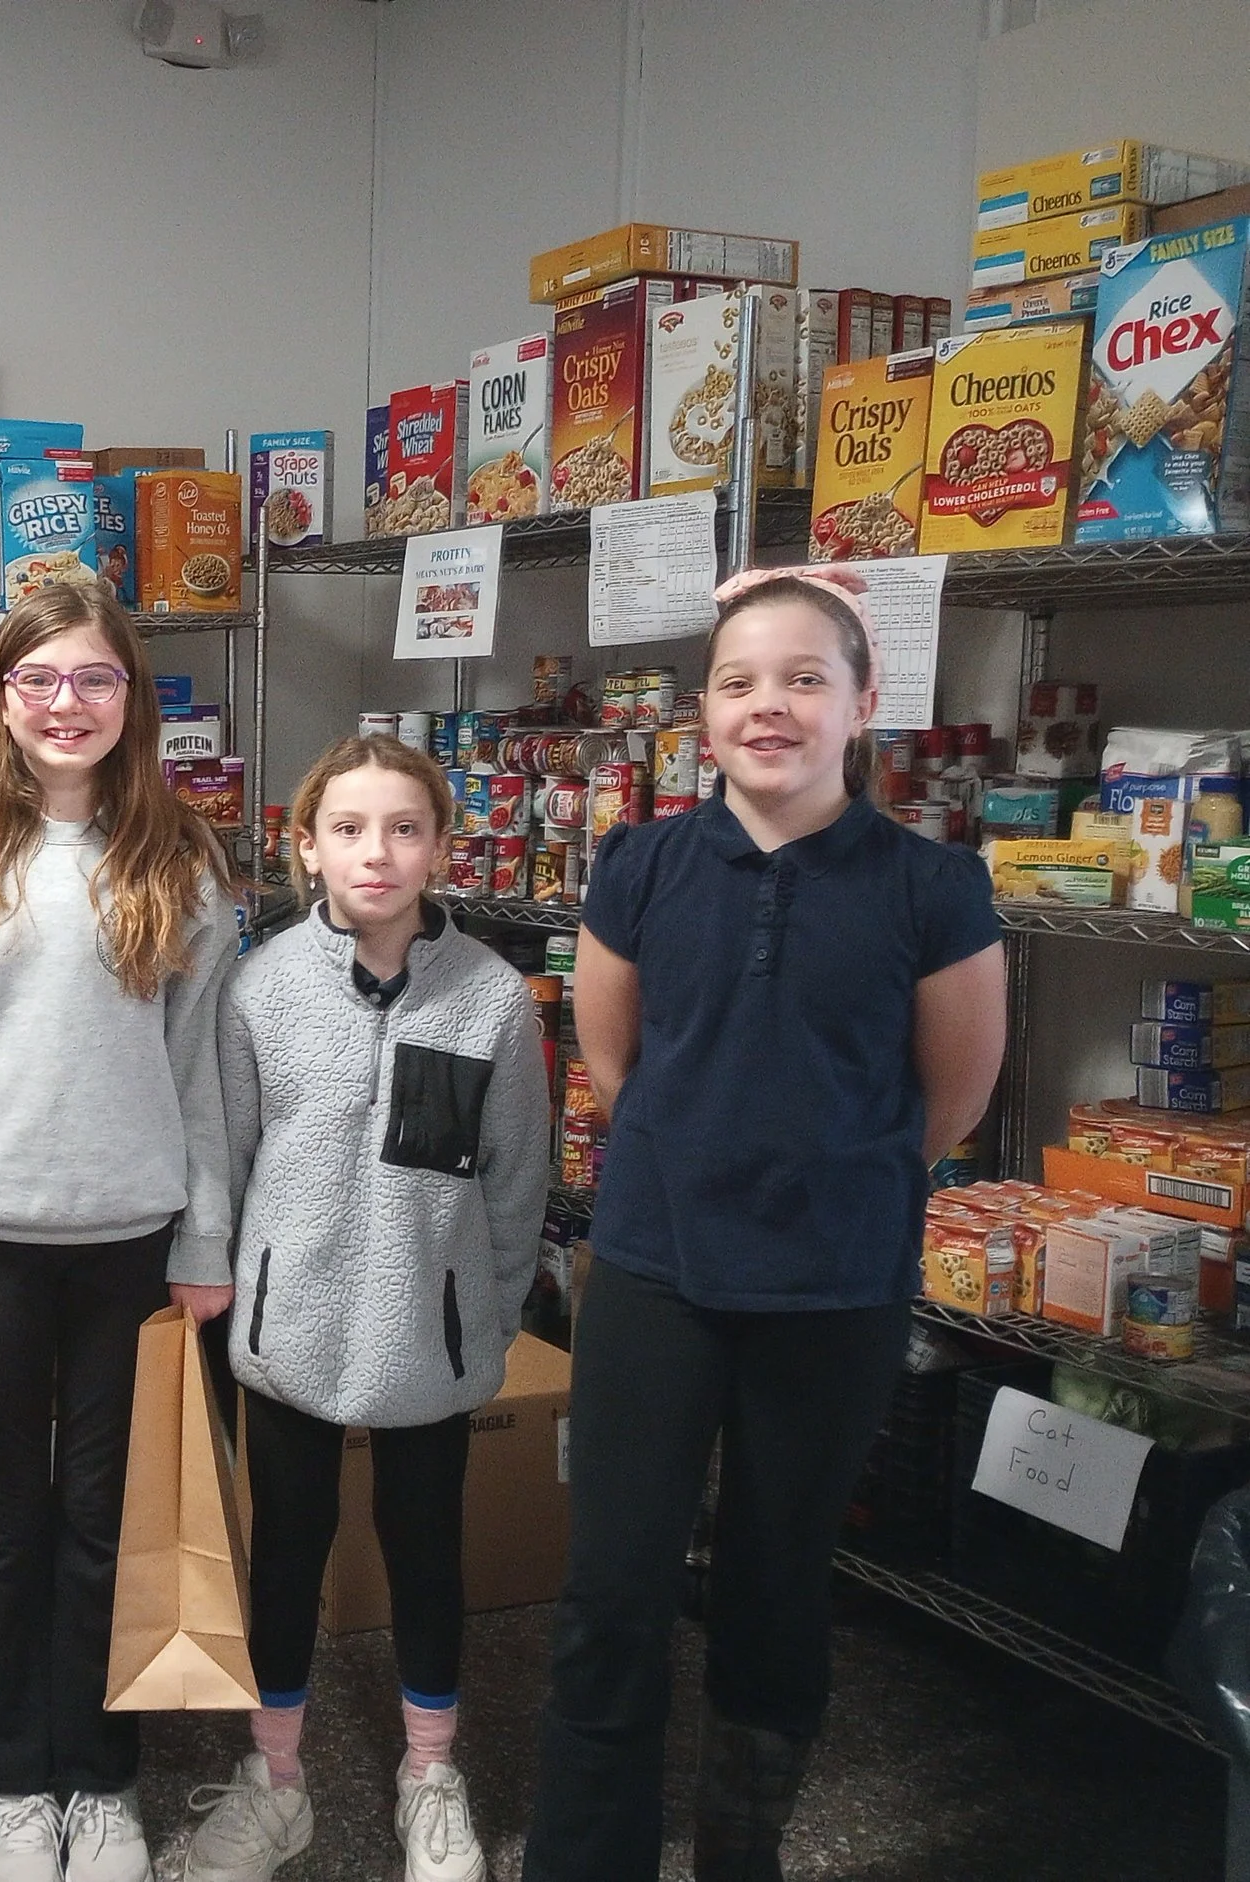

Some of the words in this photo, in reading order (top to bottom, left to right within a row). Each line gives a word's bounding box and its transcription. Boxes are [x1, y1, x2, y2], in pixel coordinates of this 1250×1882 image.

[1032, 190, 1083, 214] Cheerios
[1150, 233, 1199, 264] FAMILY
[1202, 223, 1236, 249] SIZE
[1029, 251, 1081, 273] Cheerios
[1149, 294, 1193, 321] Rice
[1107, 306, 1224, 373] Chex
[563, 350, 622, 383] Crispy
[481, 370, 527, 412] CORN
[568, 382, 609, 411] Oats
[950, 365, 1056, 408] Cheerios
[830, 396, 914, 435] Crispy
[967, 408, 994, 419] 100%
[1014, 401, 1042, 414] OATS
[397, 409, 444, 441] Shredded
[483, 406, 522, 435] FLAKES
[262, 438, 291, 447] FAMILY
[292, 437, 311, 447] SIZE
[402, 438, 434, 458] Wheat
[834, 433, 893, 468] Oats
[273, 454, 318, 477] grape
[933, 494, 967, 508] LOWER
[967, 482, 1037, 503] CHOLESTEROL
[972, 481, 988, 493] CAN
[989, 478, 1010, 490] HELP
[8, 494, 87, 525] CRISPY
[191, 509, 226, 522] Toasted
[1096, 506, 1111, 516] Free
[26, 514, 81, 541] RICE
[186, 522, 216, 536] Honey
[431, 546, 471, 563] PROTEIN
[166, 735, 213, 755] PROTEIN
[191, 776, 212, 784] TRAIL
[215, 775, 229, 783] MIX
[1128, 783, 1167, 793] purpose
[1109, 788, 1135, 812] Flo
[1016, 851, 1054, 863] Lemon
[1056, 853, 1093, 866] Ginger
[1194, 918, 1205, 928] 10
[1166, 1008, 1196, 1022] Starch
[1173, 999, 1196, 1010] Corn
[1162, 1054, 1198, 1068] Starch
[1170, 1045, 1198, 1057] Corn
[1171, 1098, 1208, 1112] Starch
[1179, 1088, 1207, 1101] Corn
[470, 1413, 517, 1434] RAGILE
[1026, 1408, 1075, 1448] Cat
[1008, 1446, 1076, 1493] Food
